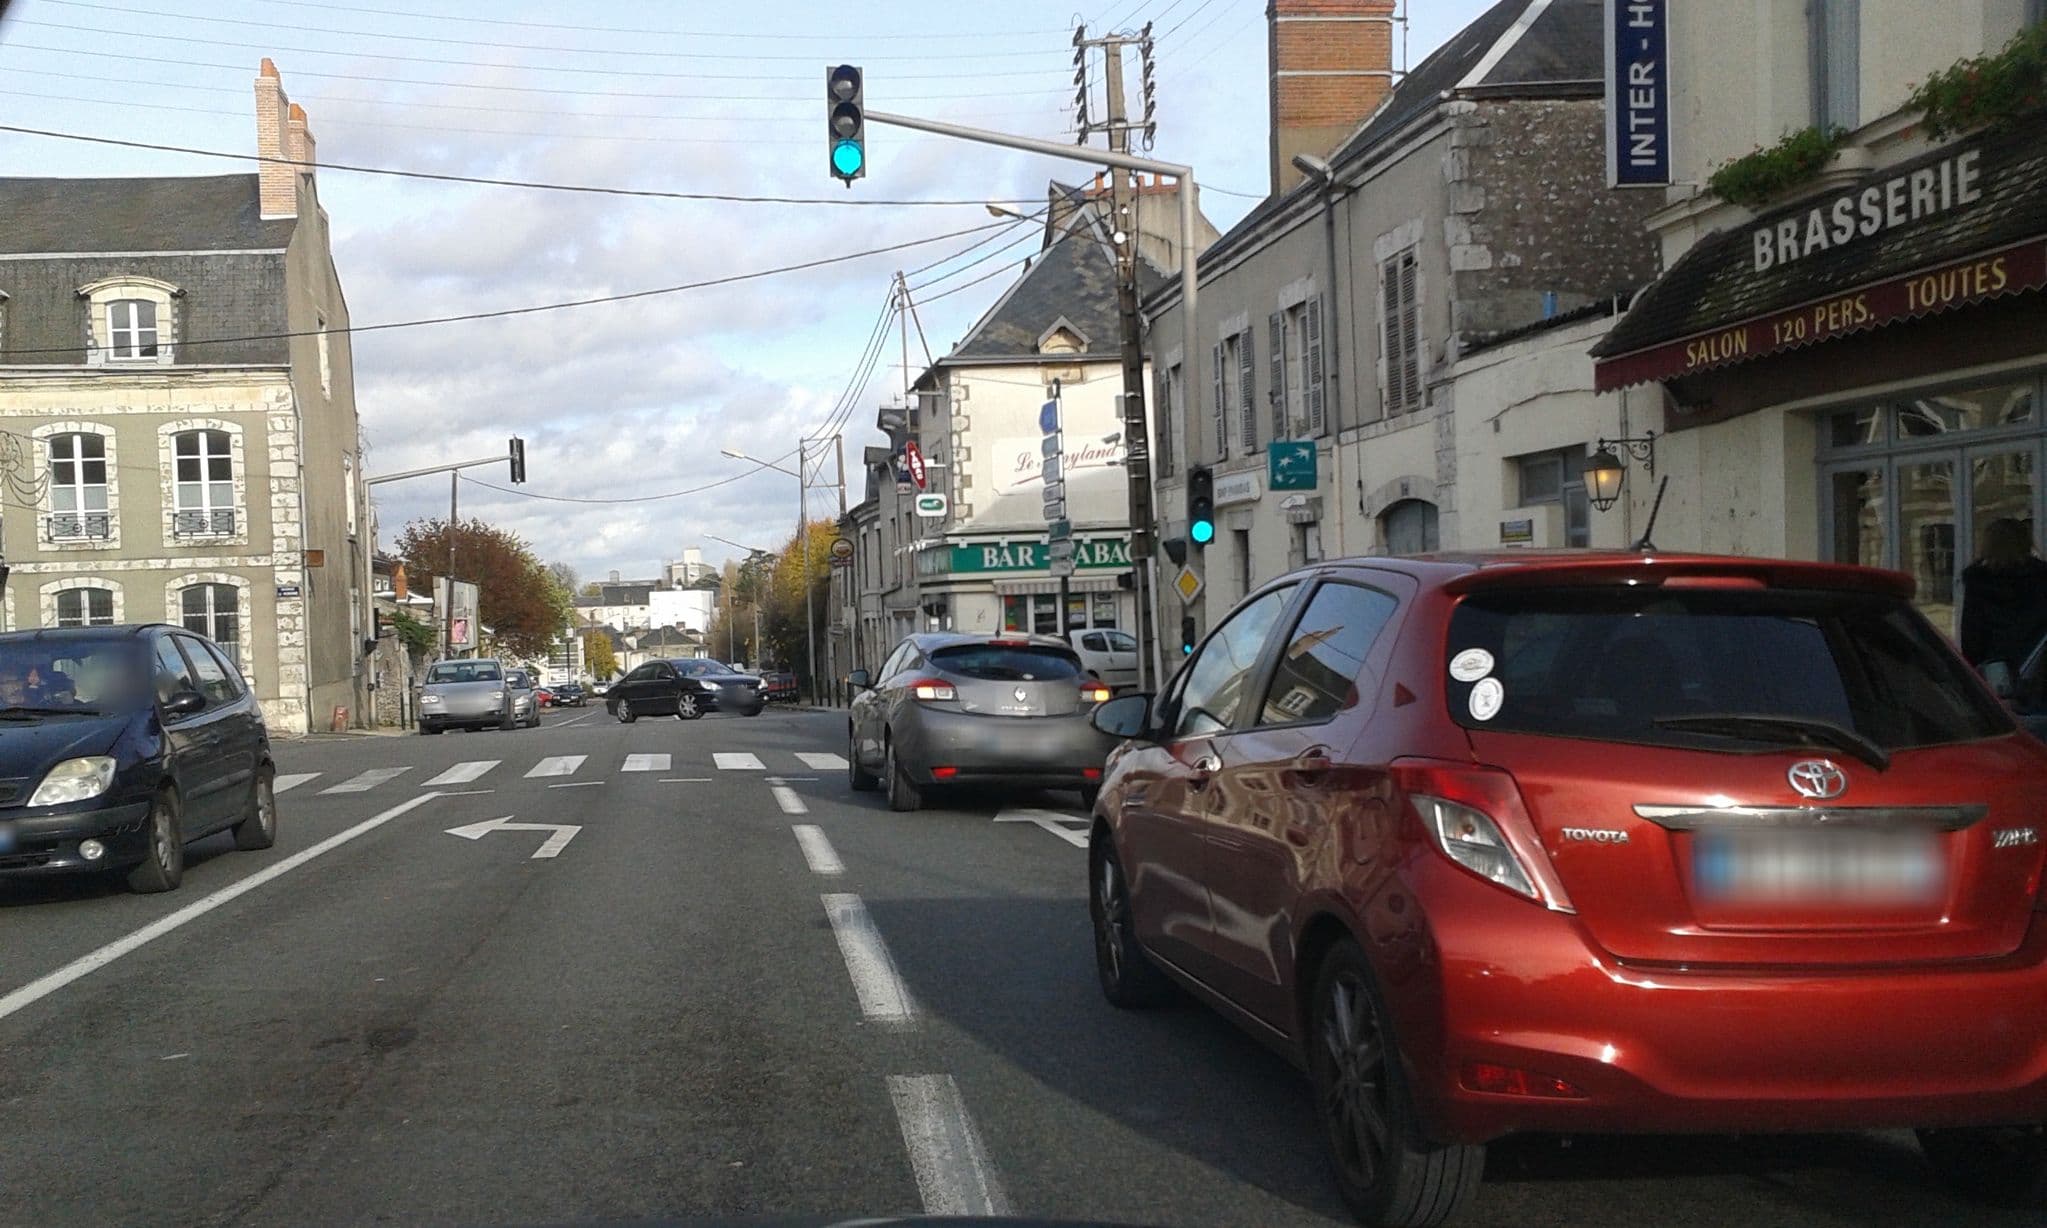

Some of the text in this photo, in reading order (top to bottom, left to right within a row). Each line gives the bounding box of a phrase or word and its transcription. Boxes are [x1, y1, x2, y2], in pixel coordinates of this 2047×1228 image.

[1629, 61, 1656, 166] INTER
[1753, 150, 1982, 273] BRASSERIE
[1686, 257, 2008, 368] SALON 120 PERS. TOUTES
[1014, 451, 1034, 473] Le
[983, 545, 1035, 568] BAR
[1562, 826, 1629, 843] TOYOTA
